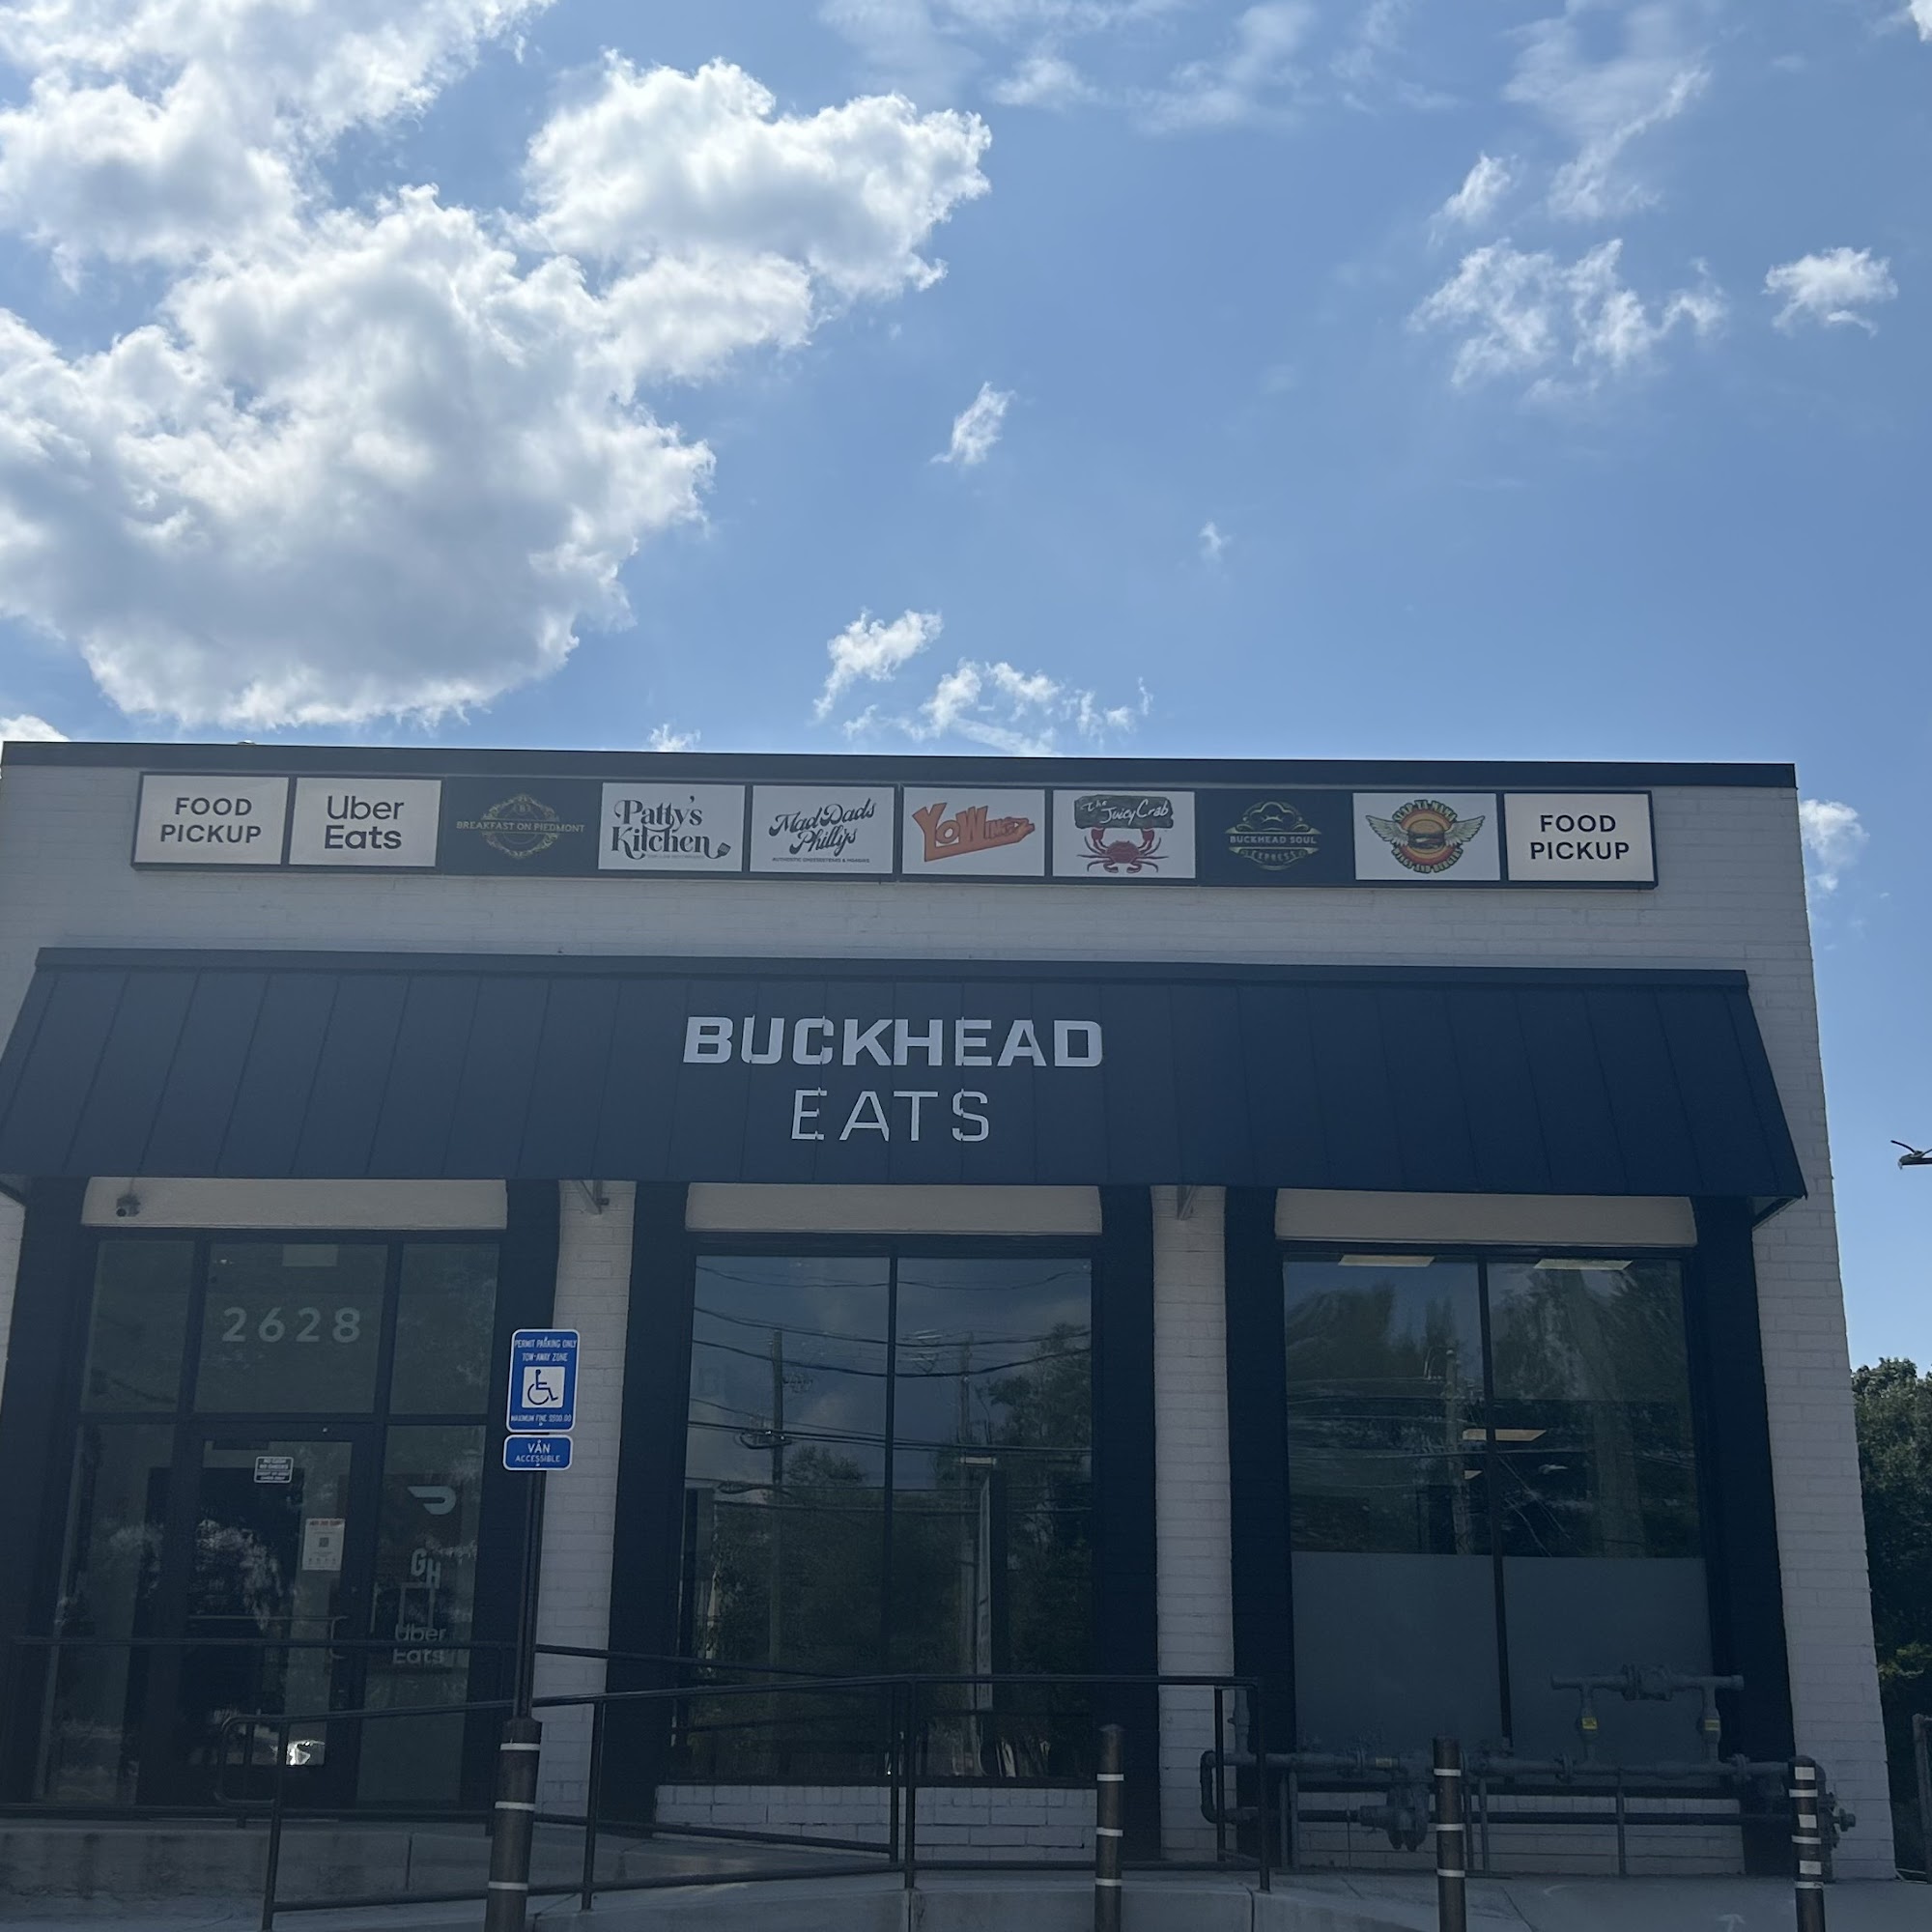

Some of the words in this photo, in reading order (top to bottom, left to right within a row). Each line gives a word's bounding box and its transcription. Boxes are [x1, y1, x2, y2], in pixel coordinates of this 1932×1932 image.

[175, 797, 252, 816] FOOD
[327, 795, 405, 820] Uber
[613, 795, 703, 833] Patty's
[1080, 800, 1107, 811] The
[1099, 806, 1137, 826] Juicy
[1135, 798, 1169, 818] Crab
[1431, 800, 1457, 822] MAMA
[456, 820, 515, 831] BREAKFAST
[516, 822, 531, 831] ON
[533, 822, 585, 833] PIEDMONT
[769, 807, 823, 837] Mad
[819, 798, 876, 827] Dads
[1540, 814, 1616, 833] FOOD
[160, 824, 262, 843] PICKUP
[325, 825, 402, 849] Eats
[611, 826, 721, 860] Kitchen
[1230, 835, 1287, 844] BUCKHEAD
[1290, 836, 1317, 844] SOUL
[1251, 850, 1296, 862] EXPRESS
[1391, 846, 1413, 869] WINGS
[1413, 864, 1432, 873] AND
[1530, 841, 1630, 860] PICKUP
[682, 1014, 1103, 1066] BUCKHEAD
[790, 1088, 990, 1142] EATS
[222, 1306, 360, 1343] 2628
[515, 1339, 535, 1349] PERMIT
[536, 1339, 561, 1349] PARKING
[562, 1339, 577, 1349] ONLY
[552, 1352, 568, 1362] ZONE
[527, 1443, 551, 1454] VAN
[394, 1622, 446, 1641] Uber
